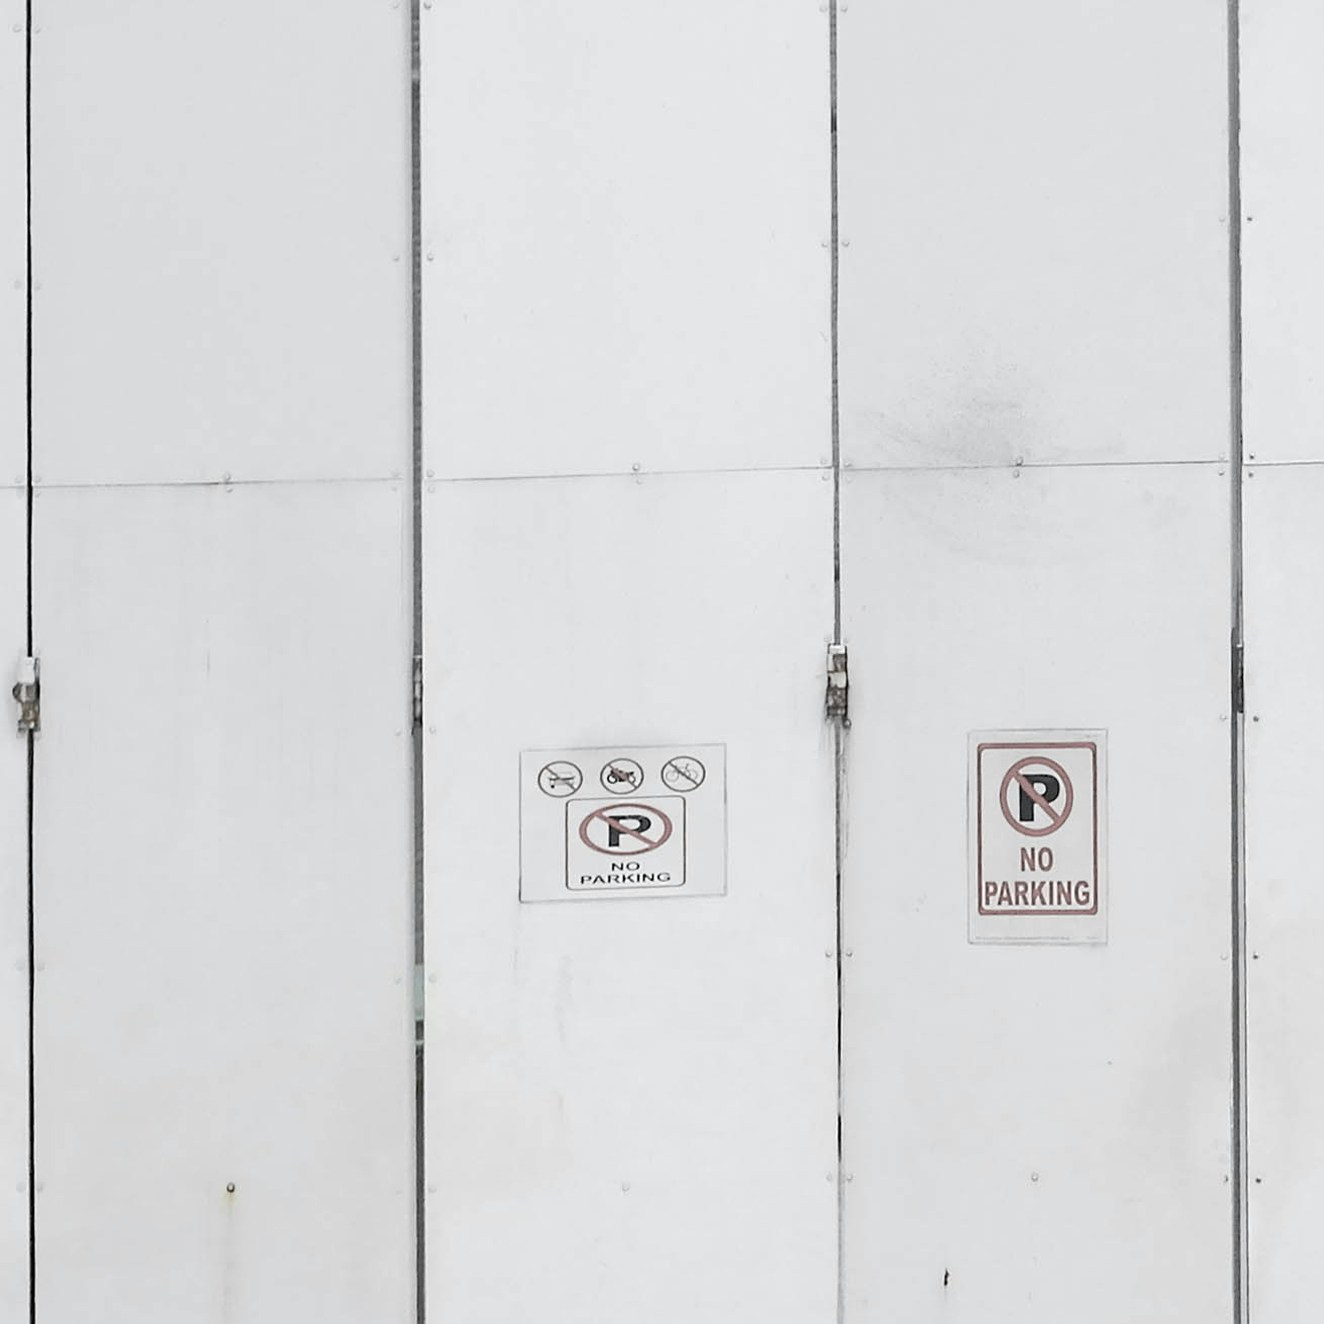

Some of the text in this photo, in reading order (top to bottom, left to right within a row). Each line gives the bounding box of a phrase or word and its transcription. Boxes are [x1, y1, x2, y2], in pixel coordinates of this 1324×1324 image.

[611, 861, 640, 871] NO
[1020, 846, 1053, 872] NO
[580, 872, 671, 885] PARKING
[984, 880, 1090, 906] PARKING
